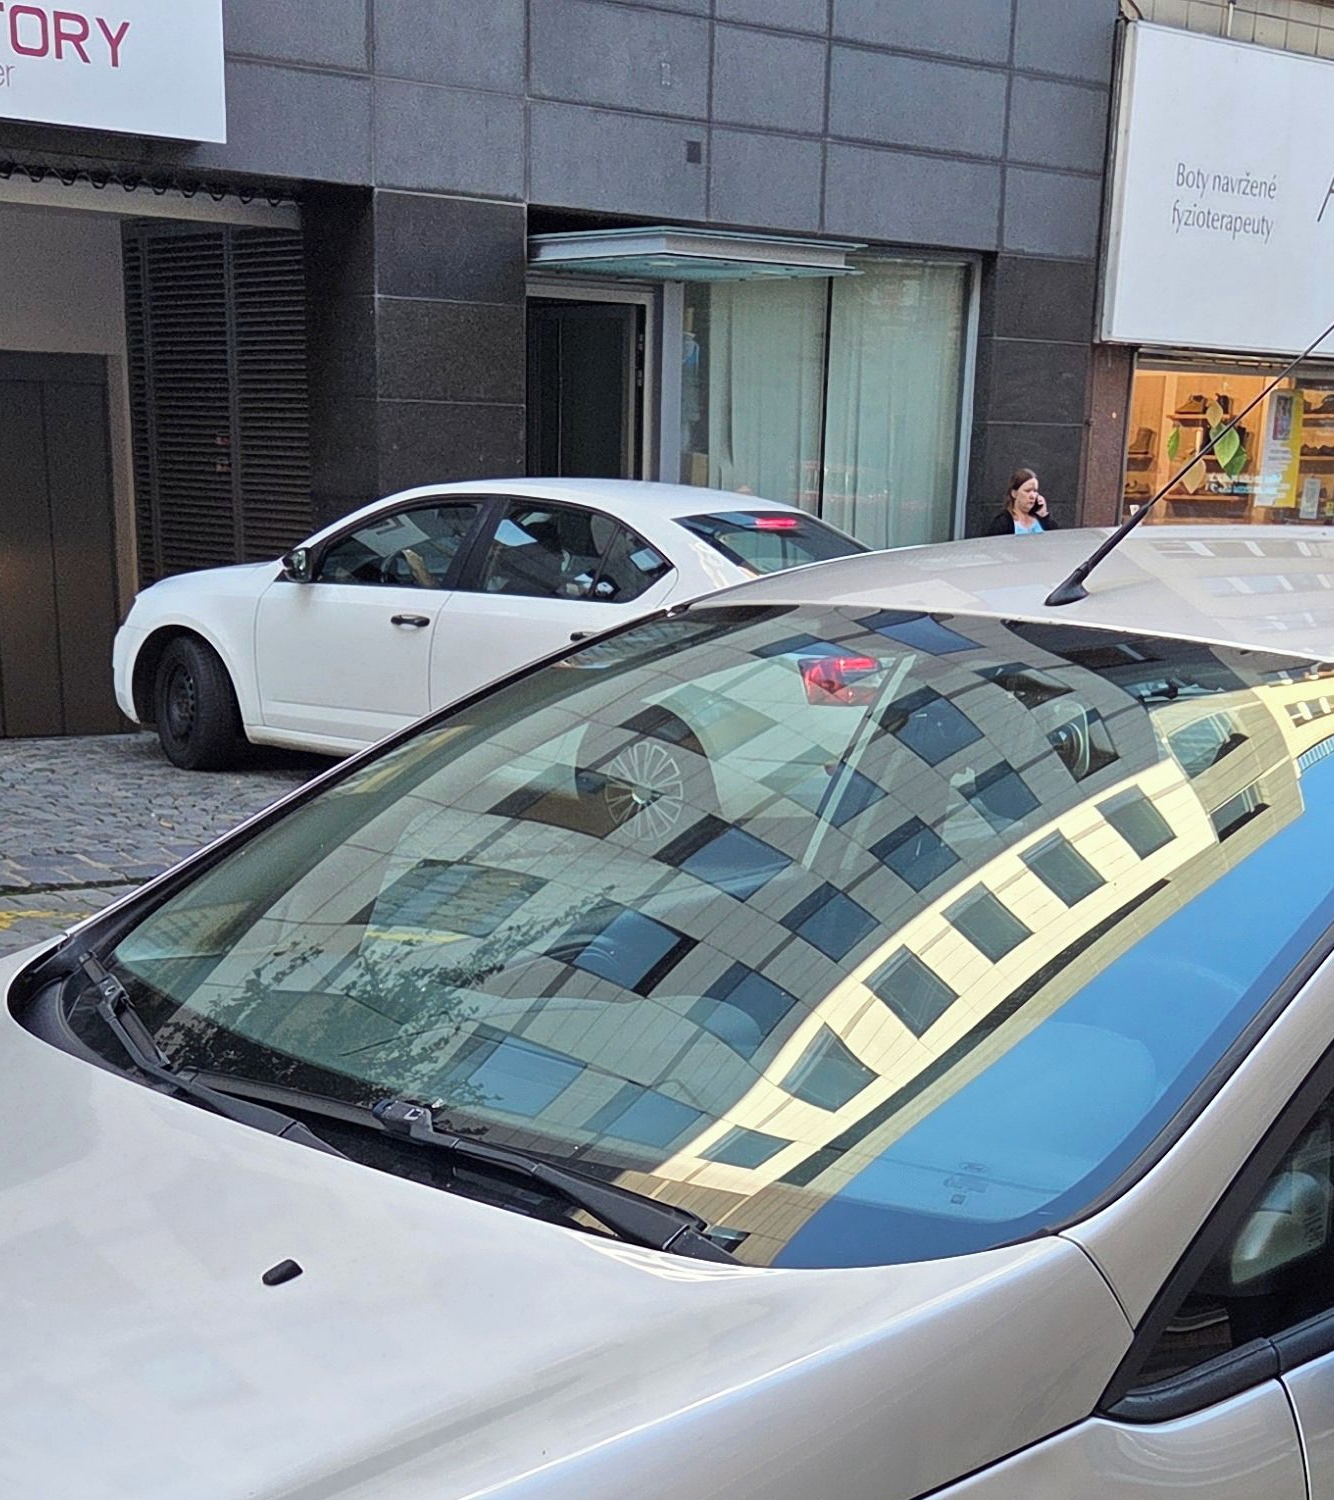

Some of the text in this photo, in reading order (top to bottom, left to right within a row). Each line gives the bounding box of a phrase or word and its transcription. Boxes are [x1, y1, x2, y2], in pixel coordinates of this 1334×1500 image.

[1176, 162, 1277, 200] Boty navržené
[1172, 200, 1274, 244] fyzioterapeuty
